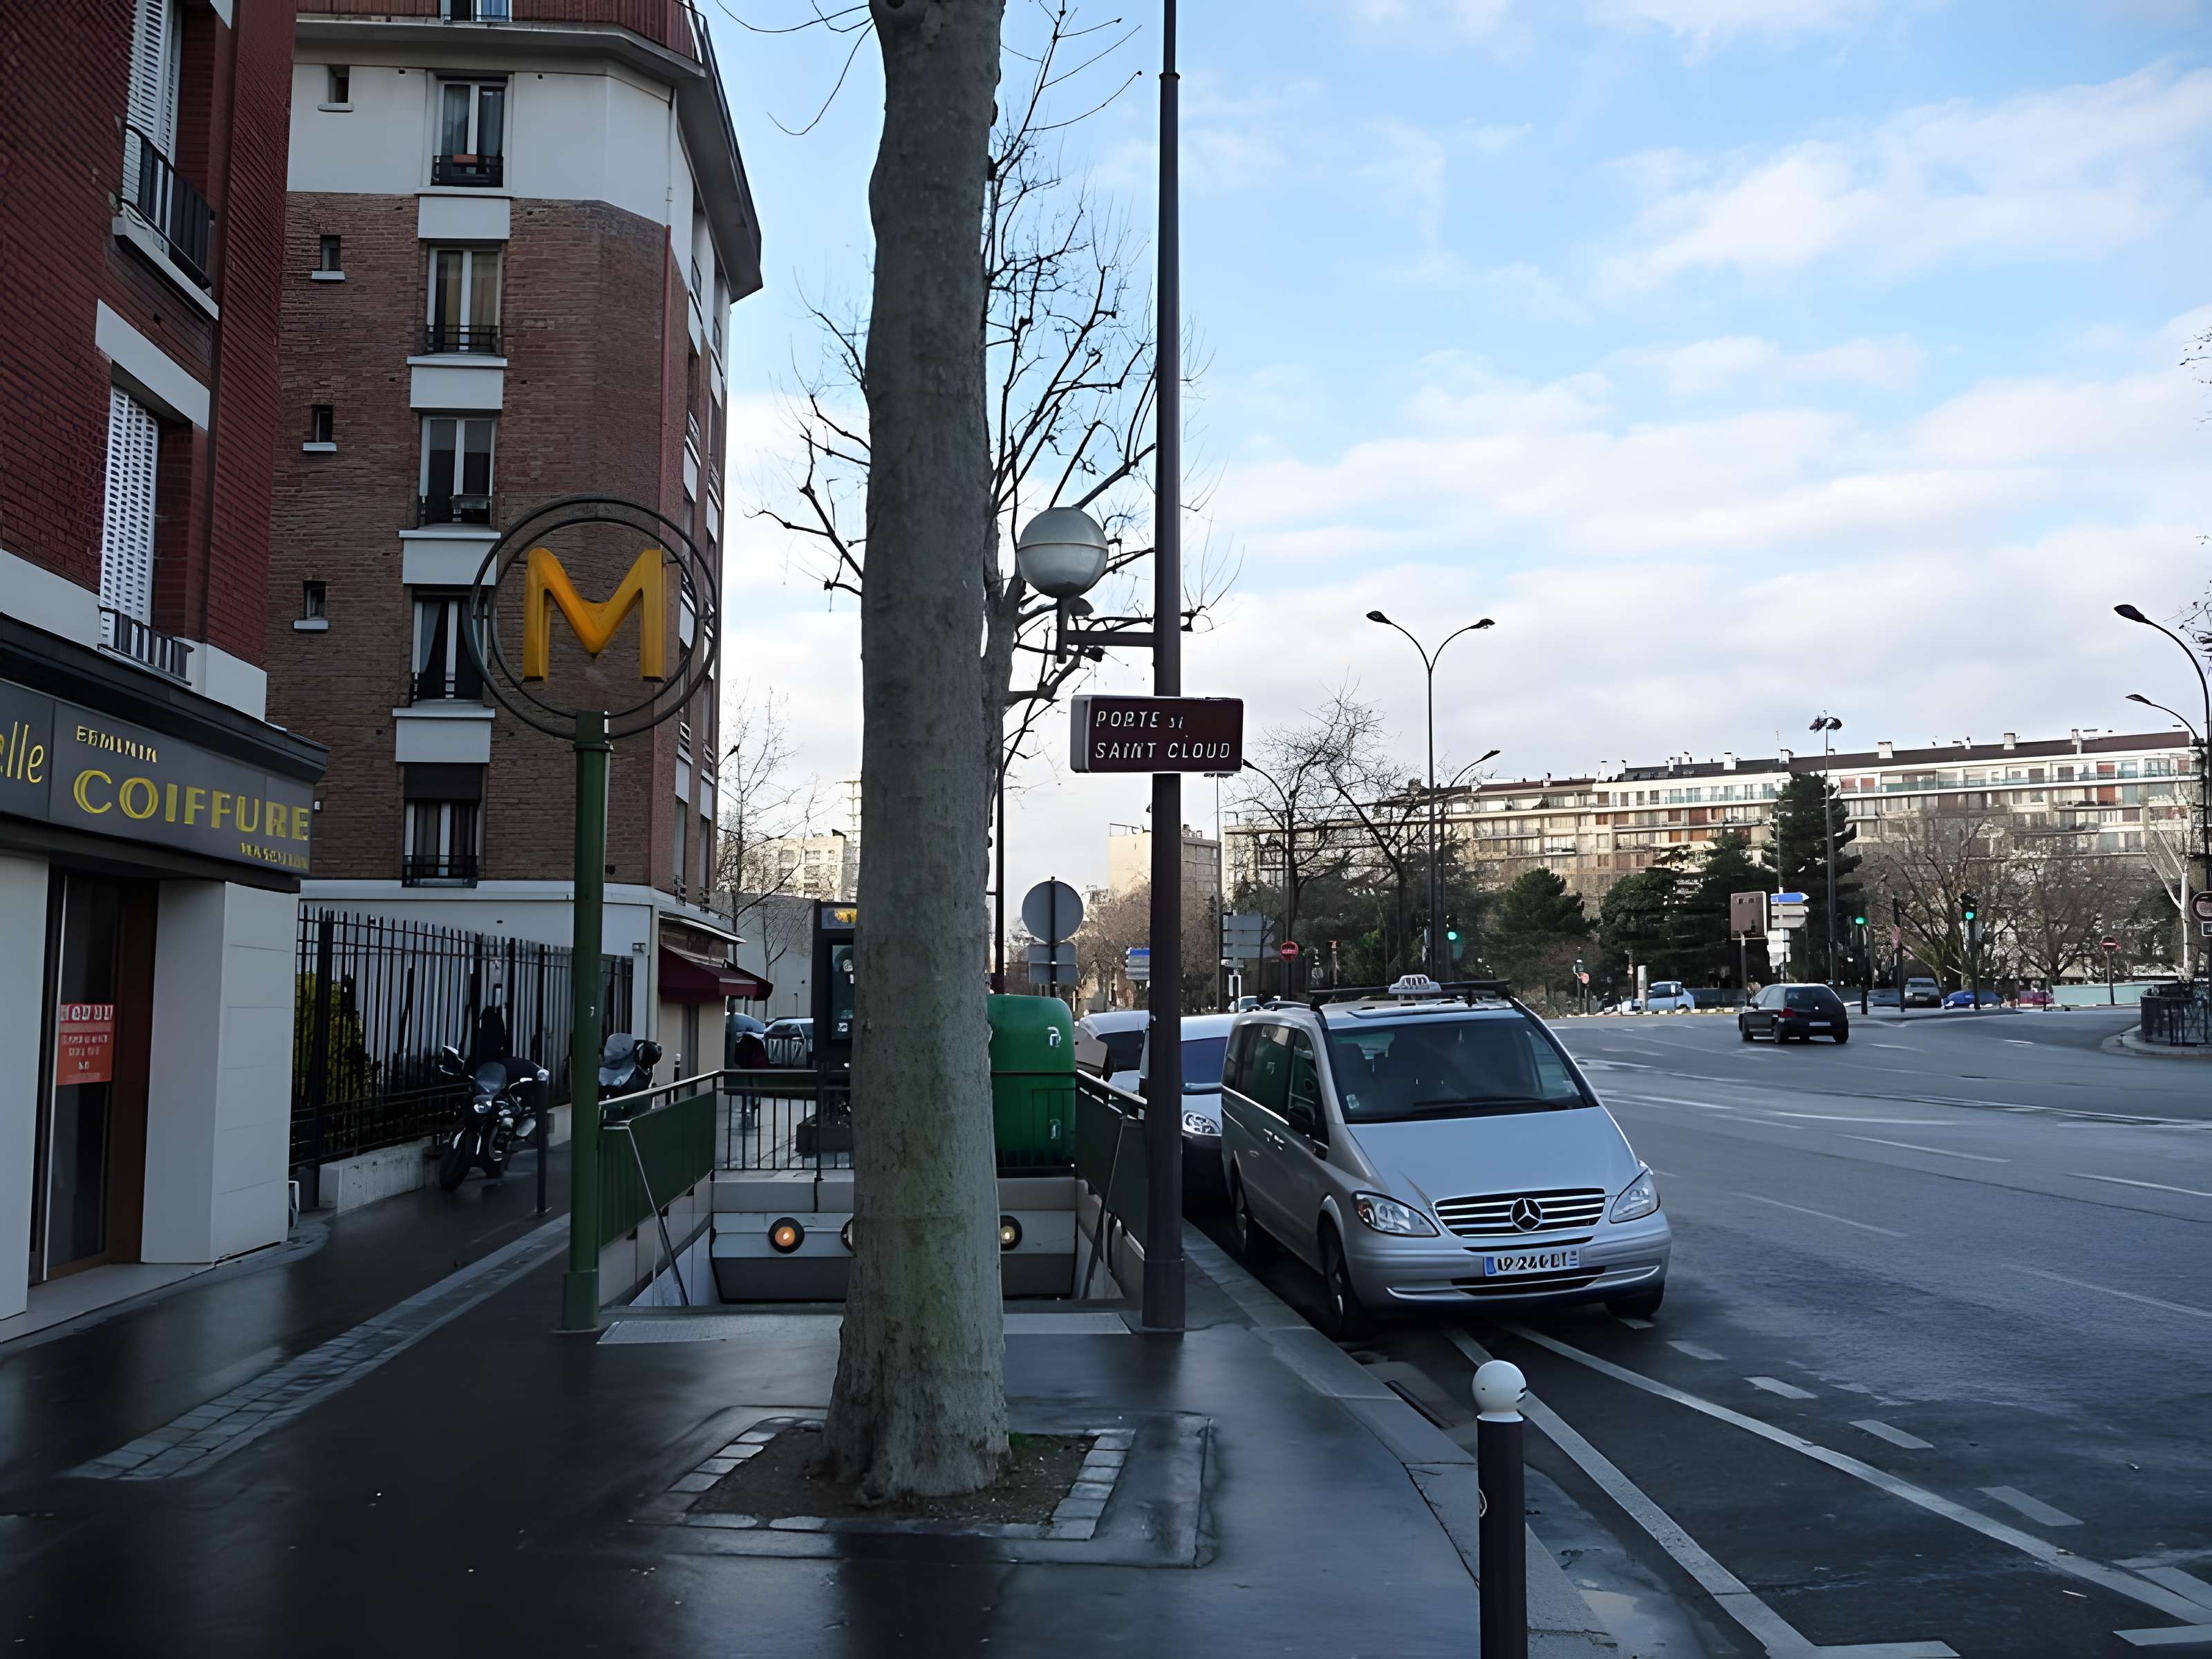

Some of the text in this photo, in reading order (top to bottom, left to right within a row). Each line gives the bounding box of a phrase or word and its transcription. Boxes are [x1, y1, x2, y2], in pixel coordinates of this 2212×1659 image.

[523, 547, 668, 683] M
[1096, 742, 1230, 759] SAINT CLOUD
[73, 769, 309, 841] COIFFURE
